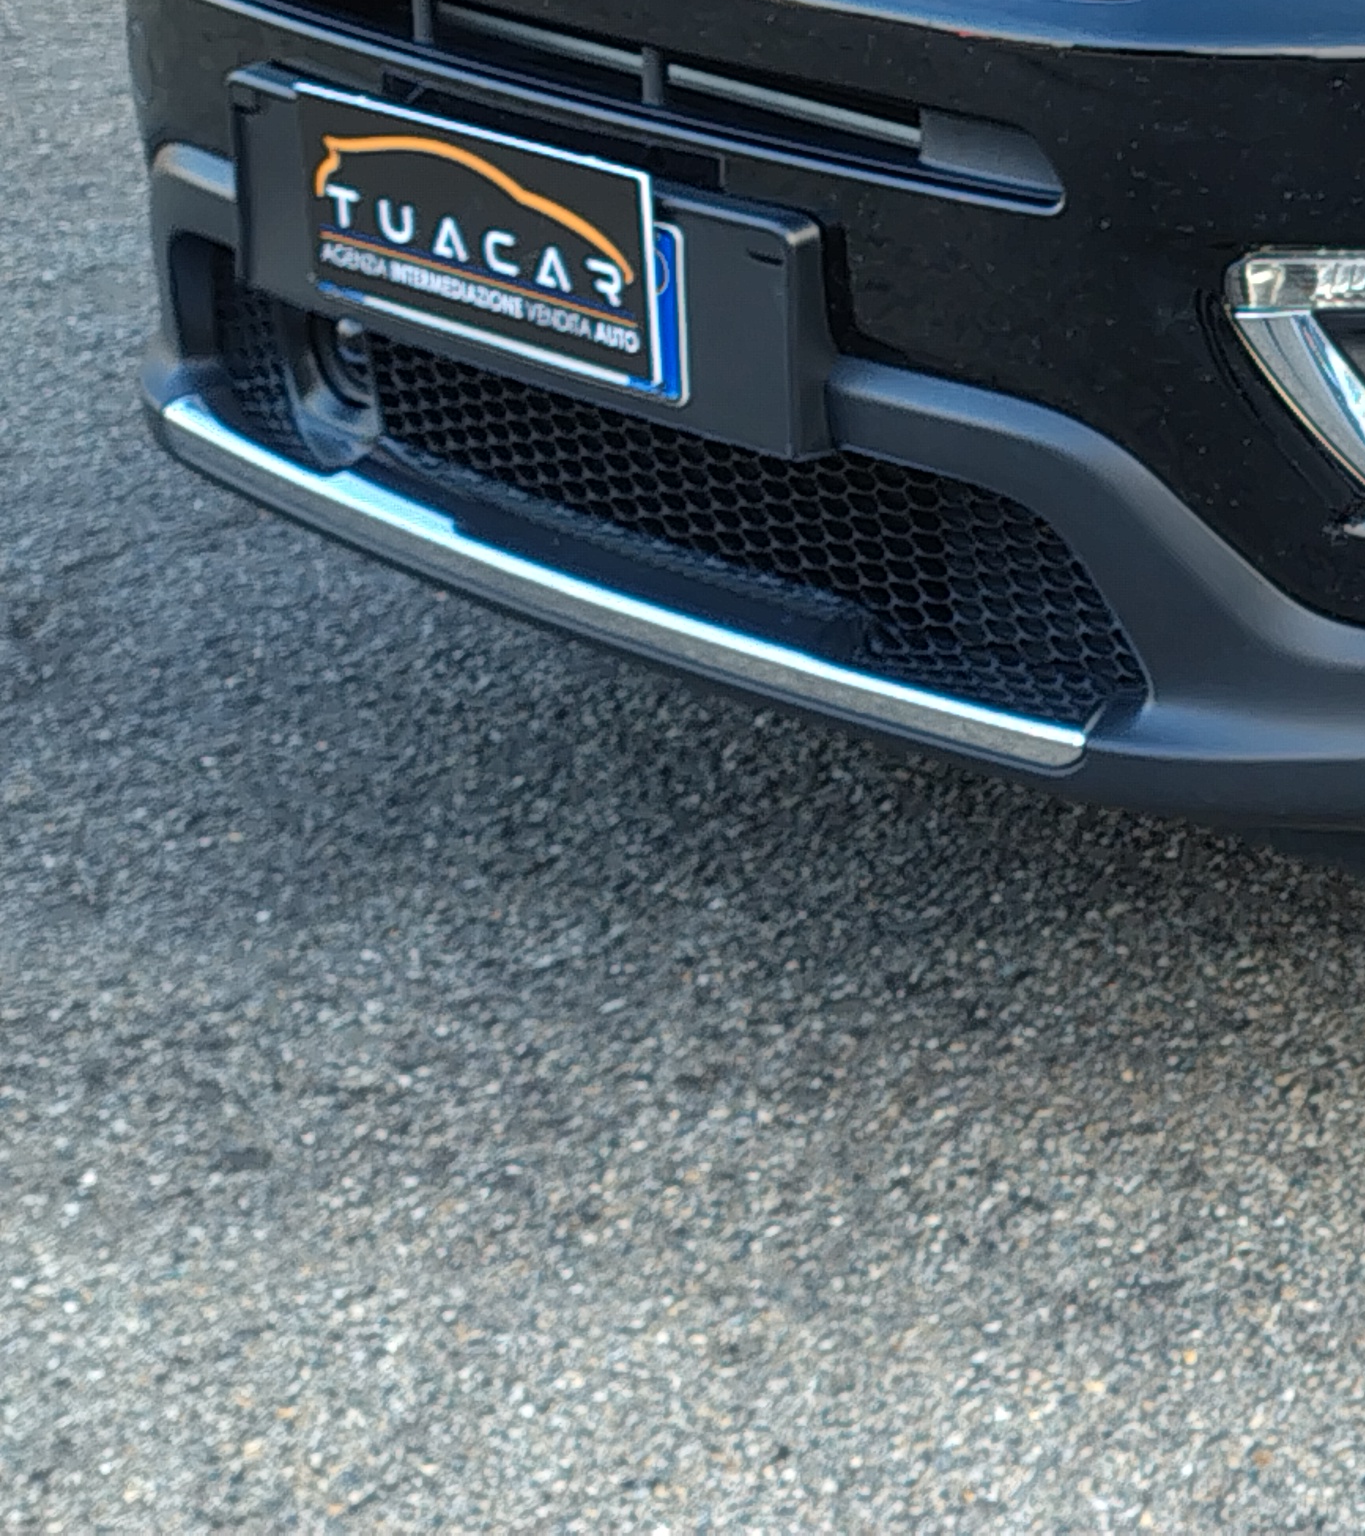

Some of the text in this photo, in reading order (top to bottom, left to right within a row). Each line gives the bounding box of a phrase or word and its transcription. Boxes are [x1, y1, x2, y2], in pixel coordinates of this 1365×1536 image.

[325, 183, 623, 308] TUACAR
[525, 300, 593, 341] VENDITA
[593, 321, 641, 354] AUTO
